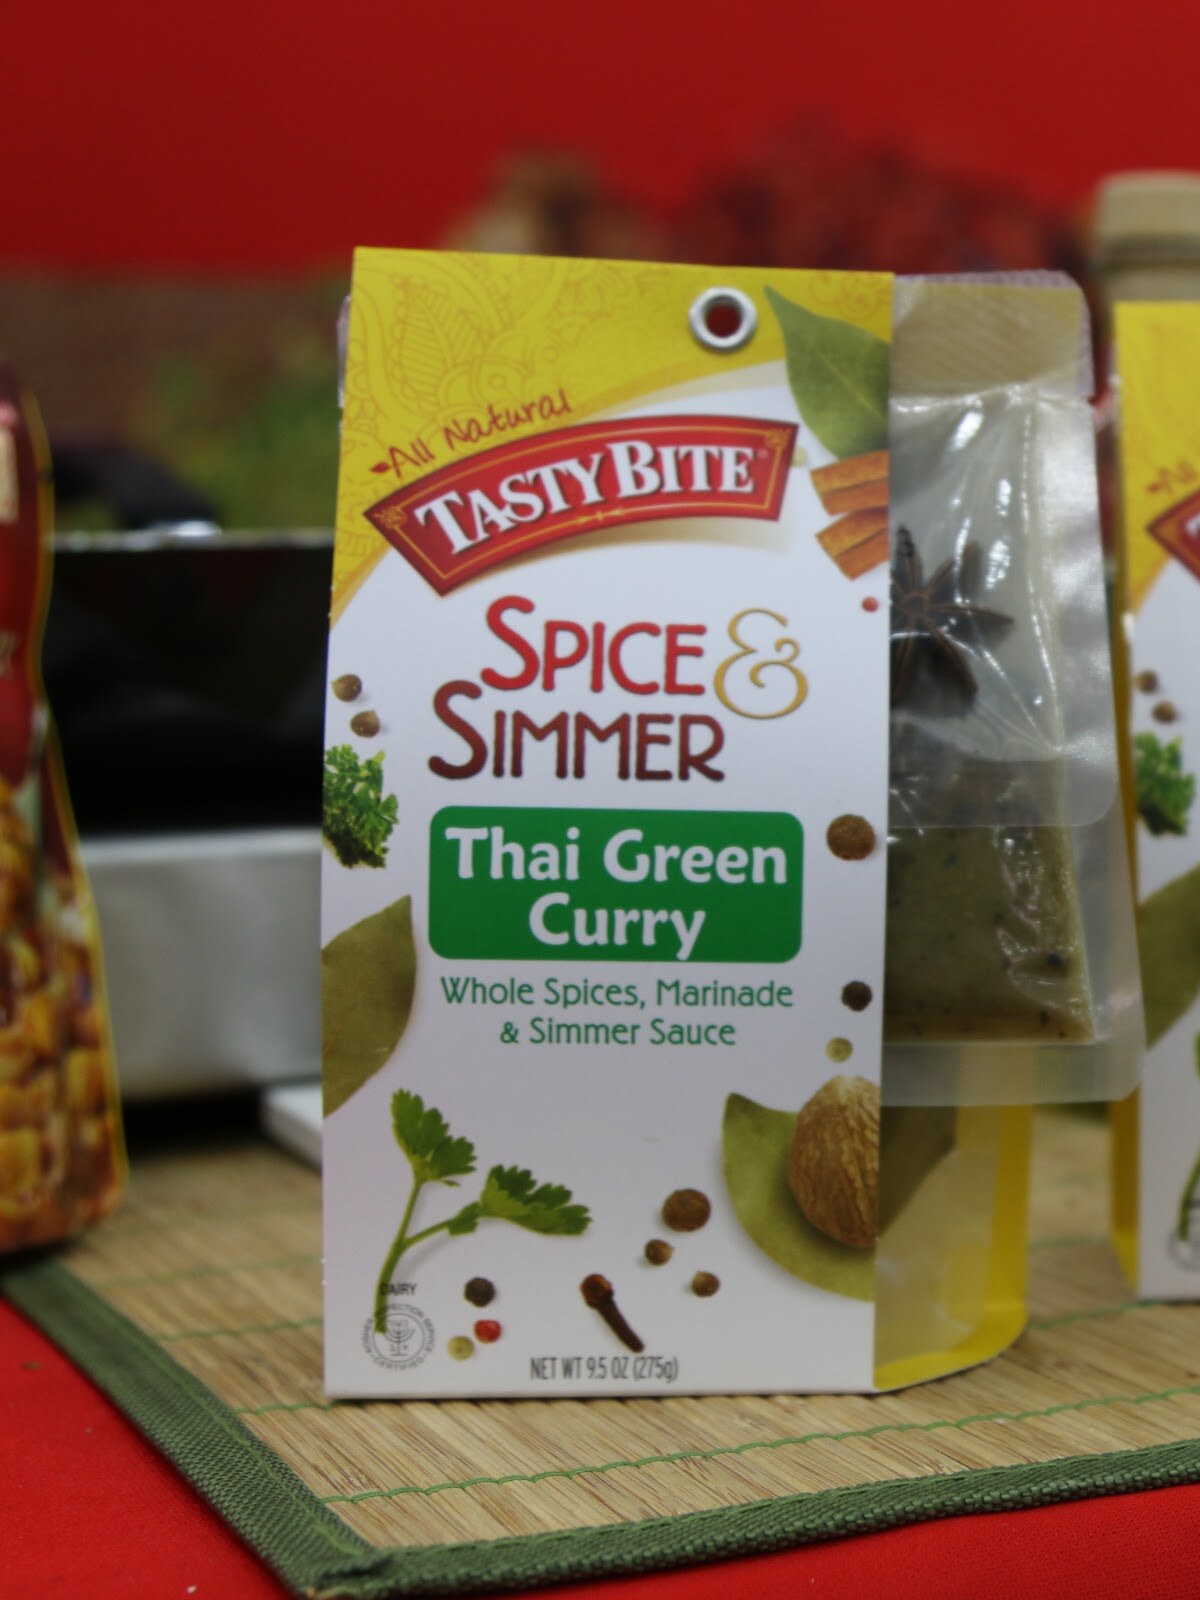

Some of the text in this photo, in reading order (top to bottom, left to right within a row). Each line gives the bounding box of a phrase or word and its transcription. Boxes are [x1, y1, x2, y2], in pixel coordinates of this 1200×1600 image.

[388, 387, 572, 480] All Natural
[416, 441, 755, 554] TASTY BITE
[481, 595, 808, 720] SPICE &
[428, 680, 725, 781] SIMMER
[445, 826, 788, 884] Thai Green
[529, 891, 707, 961] Curry
[440, 976, 794, 1011] Whole Spices, Marinade
[500, 1017, 736, 1046] & Simmer Sauce
[381, 1283, 417, 1296] DAIRY
[530, 1356, 557, 1380] NET
[561, 1356, 583, 1380] WT
[611, 1356, 630, 1380] OZ
[632, 1355, 680, 1384] (275g)
